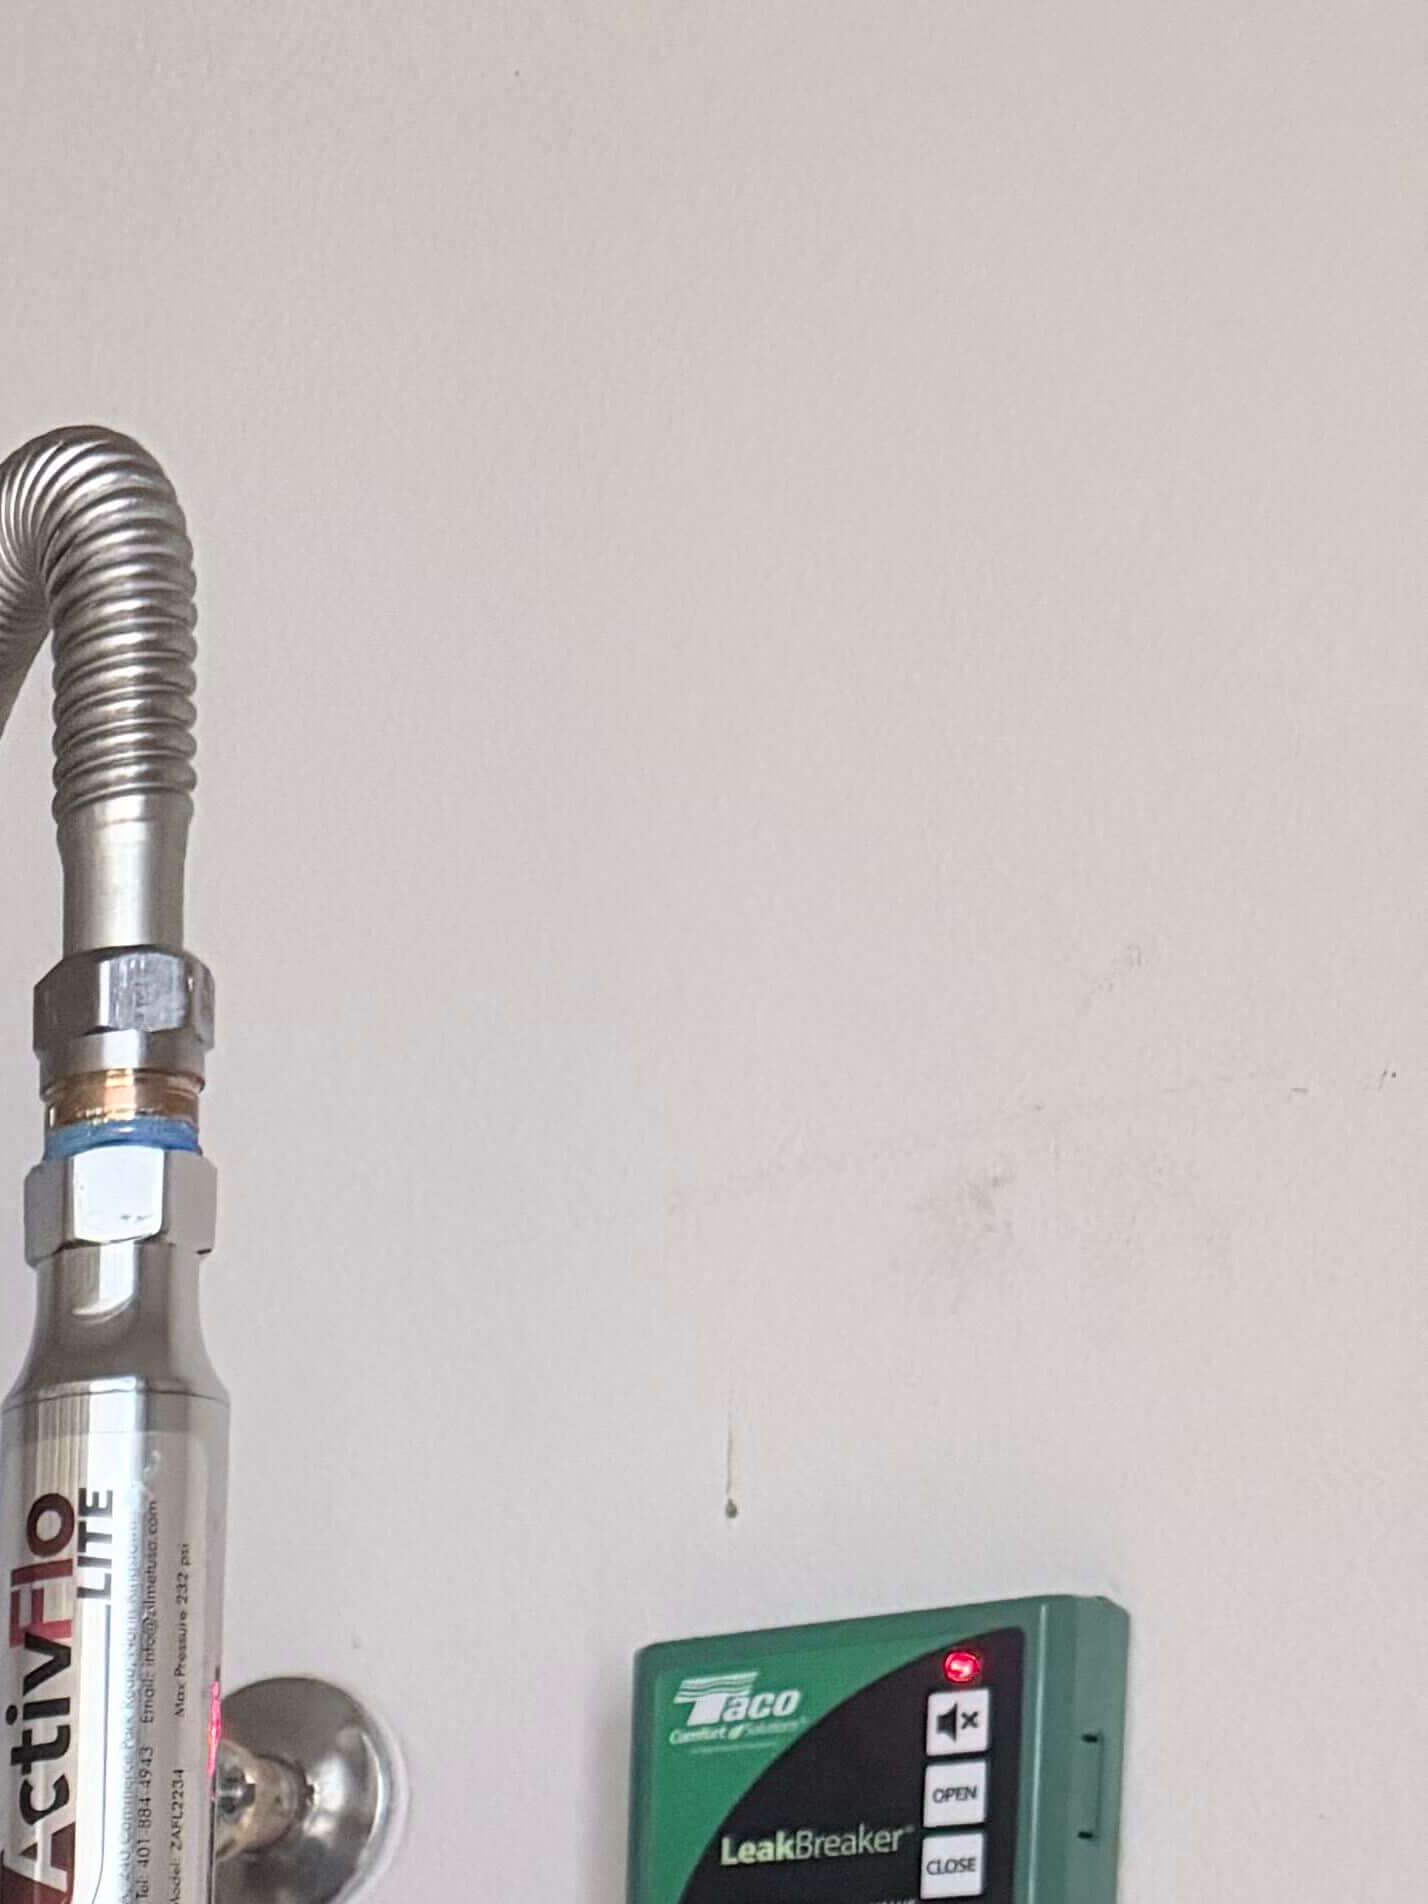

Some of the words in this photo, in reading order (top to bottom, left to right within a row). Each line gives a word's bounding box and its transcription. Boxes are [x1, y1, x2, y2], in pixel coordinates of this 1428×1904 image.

[77, 1487, 113, 1599] LITE
[177, 1571, 190, 1605] 232
[673, 1671, 801, 1727] Taco
[932, 1785, 978, 1804] OPEN
[926, 1856, 976, 1875] CLOSE
